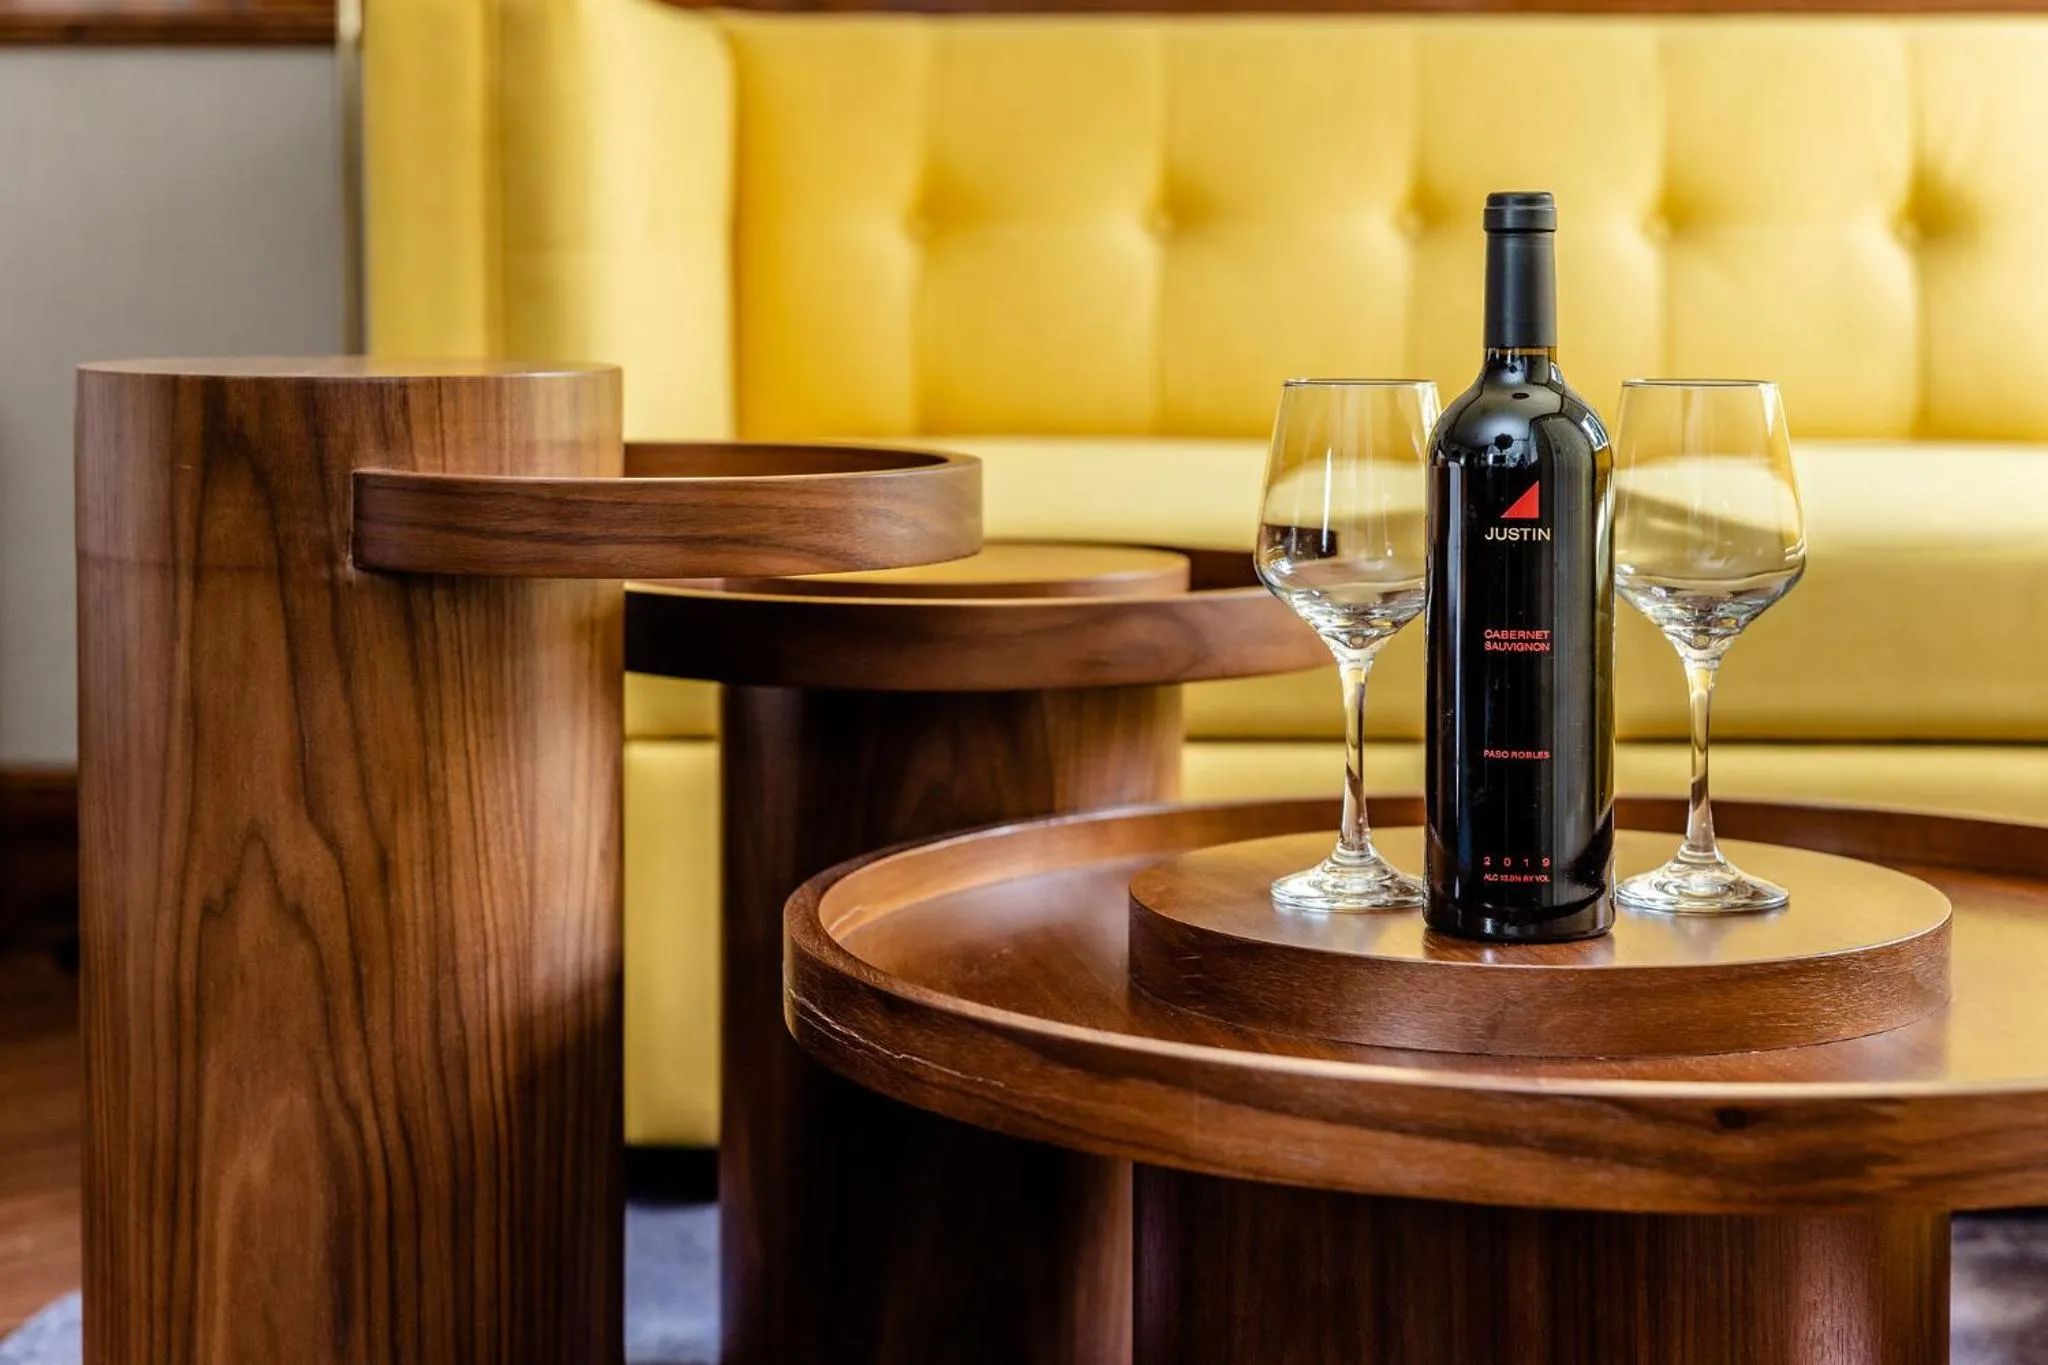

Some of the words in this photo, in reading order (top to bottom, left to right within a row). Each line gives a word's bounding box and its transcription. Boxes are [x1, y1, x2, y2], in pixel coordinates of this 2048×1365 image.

[1485, 526, 1551, 541] JUSTIN
[1484, 629, 1551, 640] CABERNET
[1484, 641, 1551, 652] SAUVIGNON
[1483, 749, 1509, 759] PASO
[1510, 751, 1551, 760] ROBLES
[1483, 873, 1498, 881] ALC
[1523, 874, 1534, 882] BY
